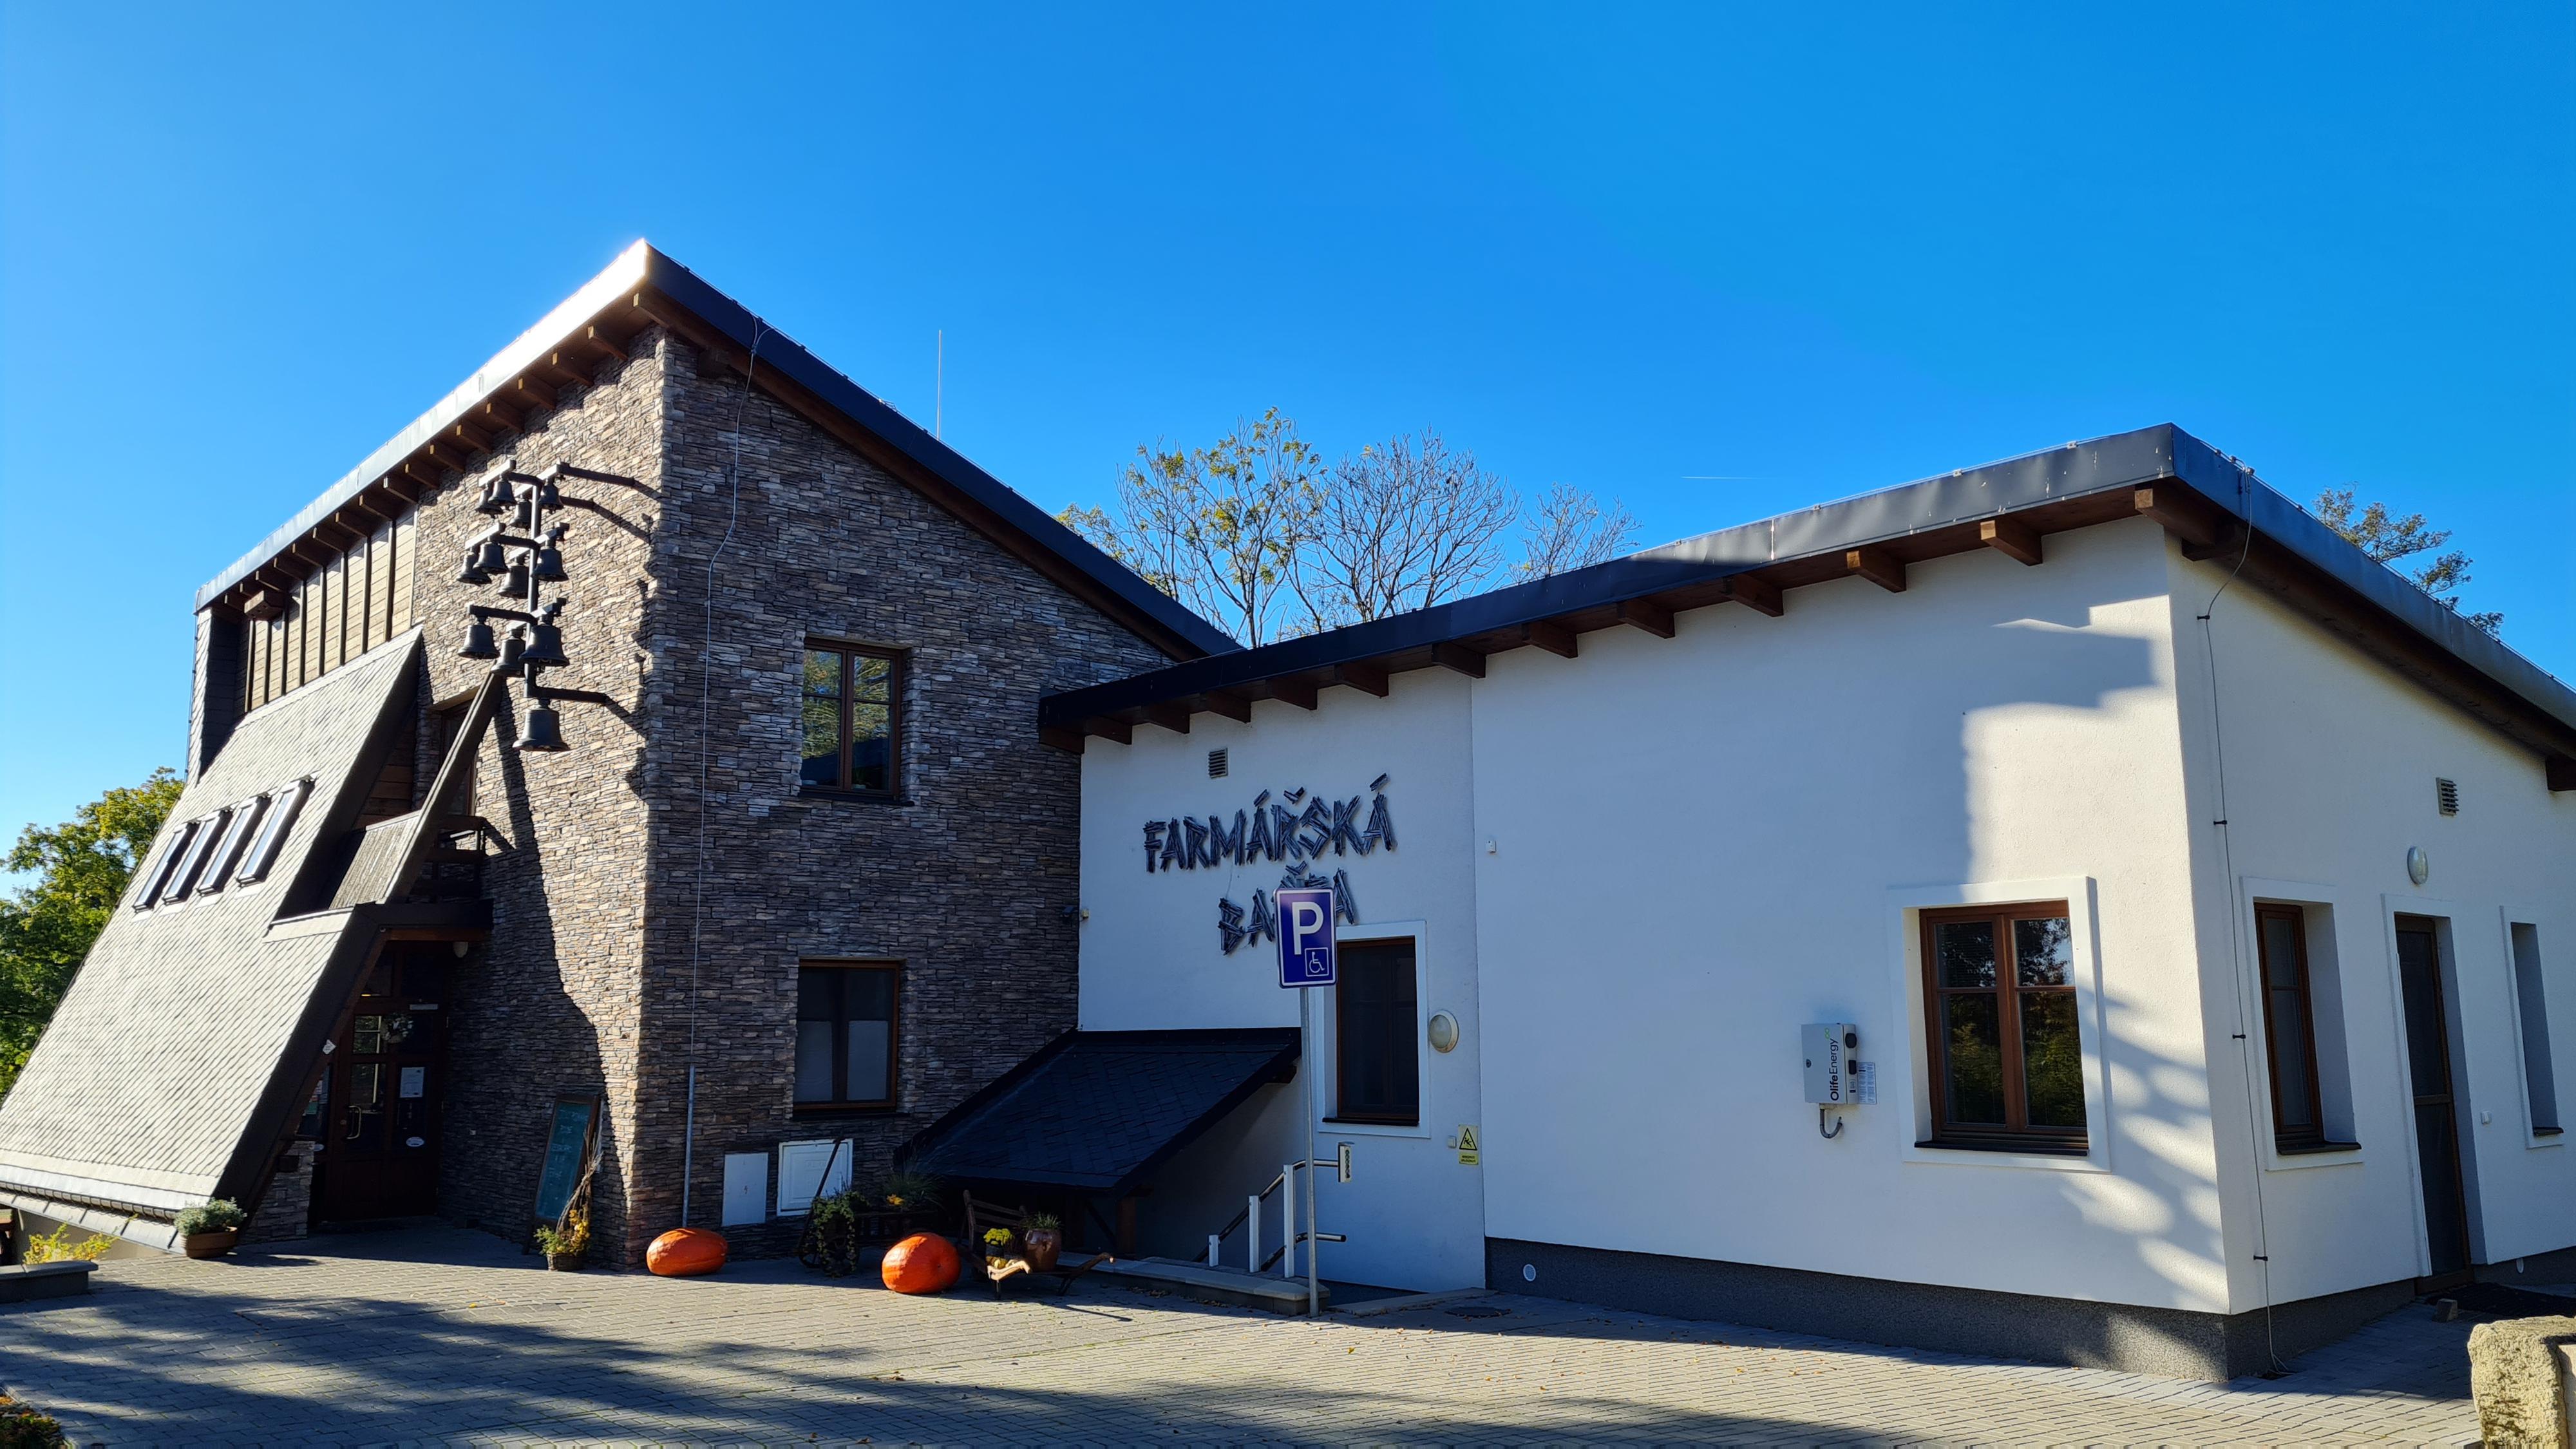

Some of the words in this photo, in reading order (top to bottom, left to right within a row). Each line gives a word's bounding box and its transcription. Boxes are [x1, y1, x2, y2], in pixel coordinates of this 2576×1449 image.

[1143, 773, 1392, 873] FARMÁŘSKÁ
[1218, 860, 1355, 956] BAA
[1292, 902, 1324, 955] P
[1829, 1038, 1839, 1101] OlifeEnergy
